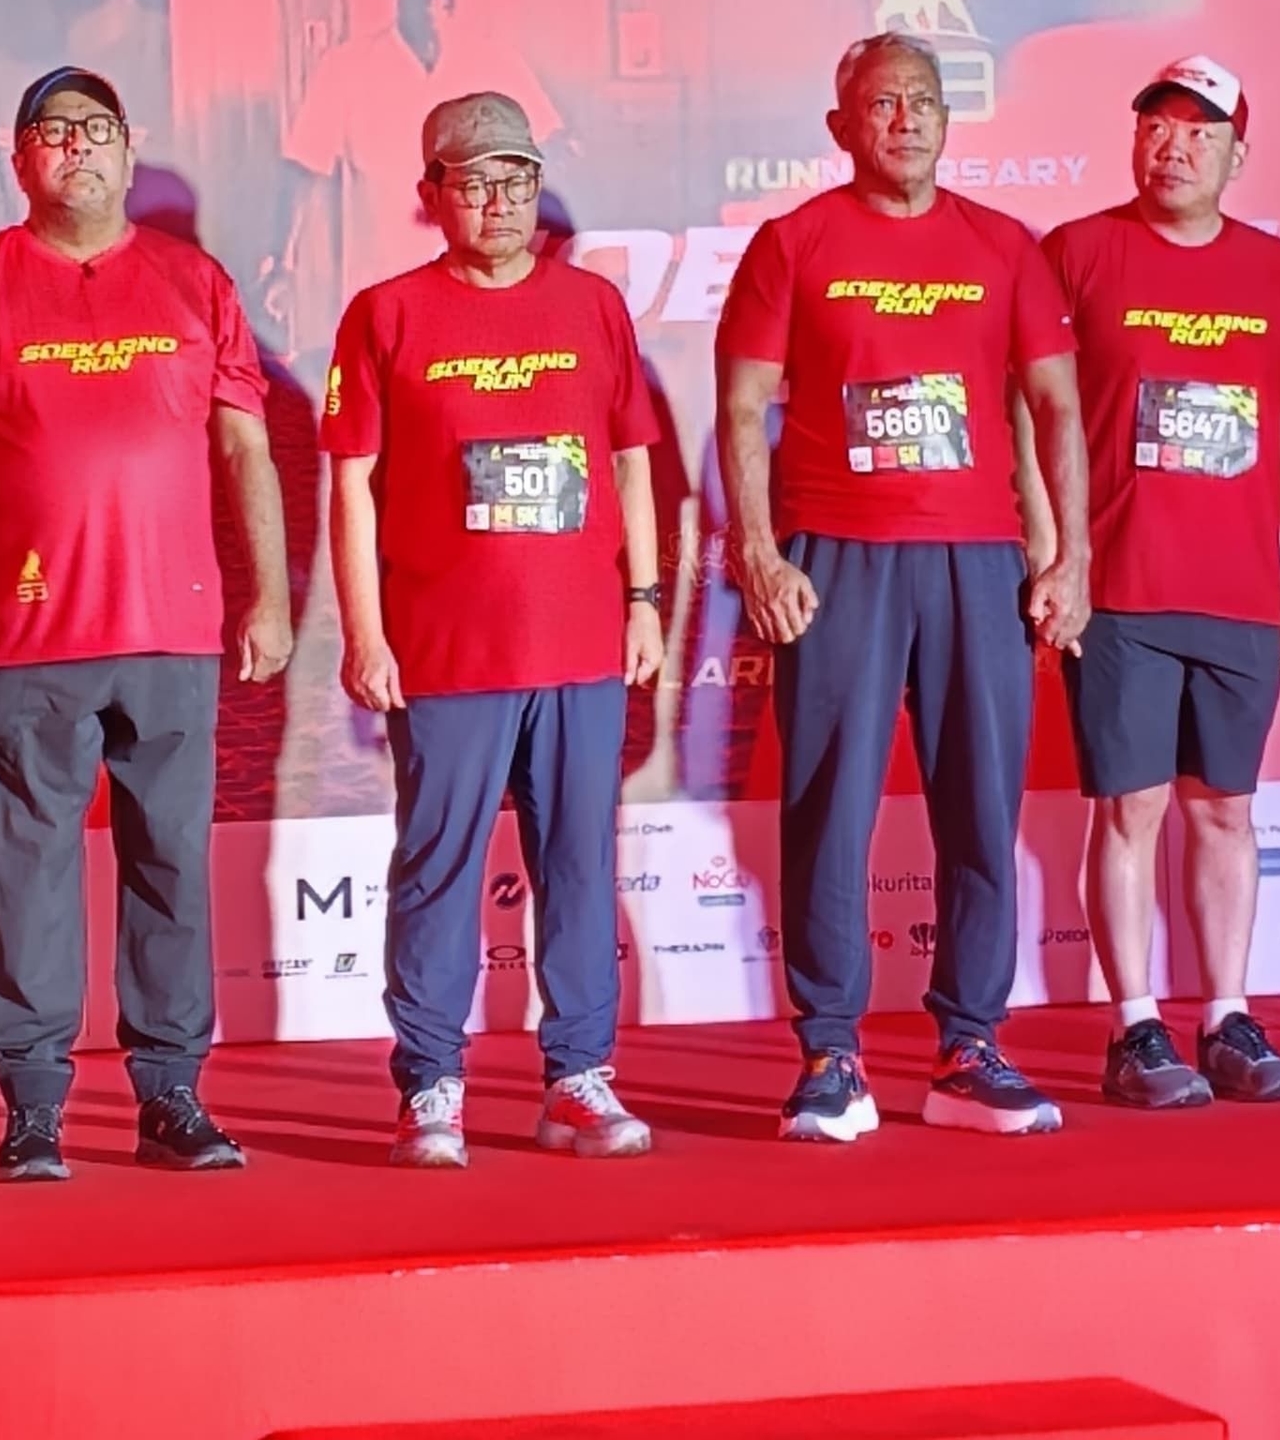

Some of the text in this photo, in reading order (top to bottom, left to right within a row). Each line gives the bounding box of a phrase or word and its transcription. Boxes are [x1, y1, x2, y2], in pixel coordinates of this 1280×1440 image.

[724, 156, 1089, 192] RUNNRSARY
[826, 280, 984, 301] SOEKARNO
[875, 296, 937, 315] RUN
[1123, 310, 1268, 334] SOEKARNO
[19, 336, 178, 363] SOEKARNO
[1169, 328, 1228, 347] RUN
[70, 355, 134, 375] RUN
[425, 352, 578, 381] SOEKARNO
[474, 370, 534, 392] RUN
[865, 405, 951, 439] 56610
[503, 466, 559, 498] 501
[296, 876, 353, 921] M
